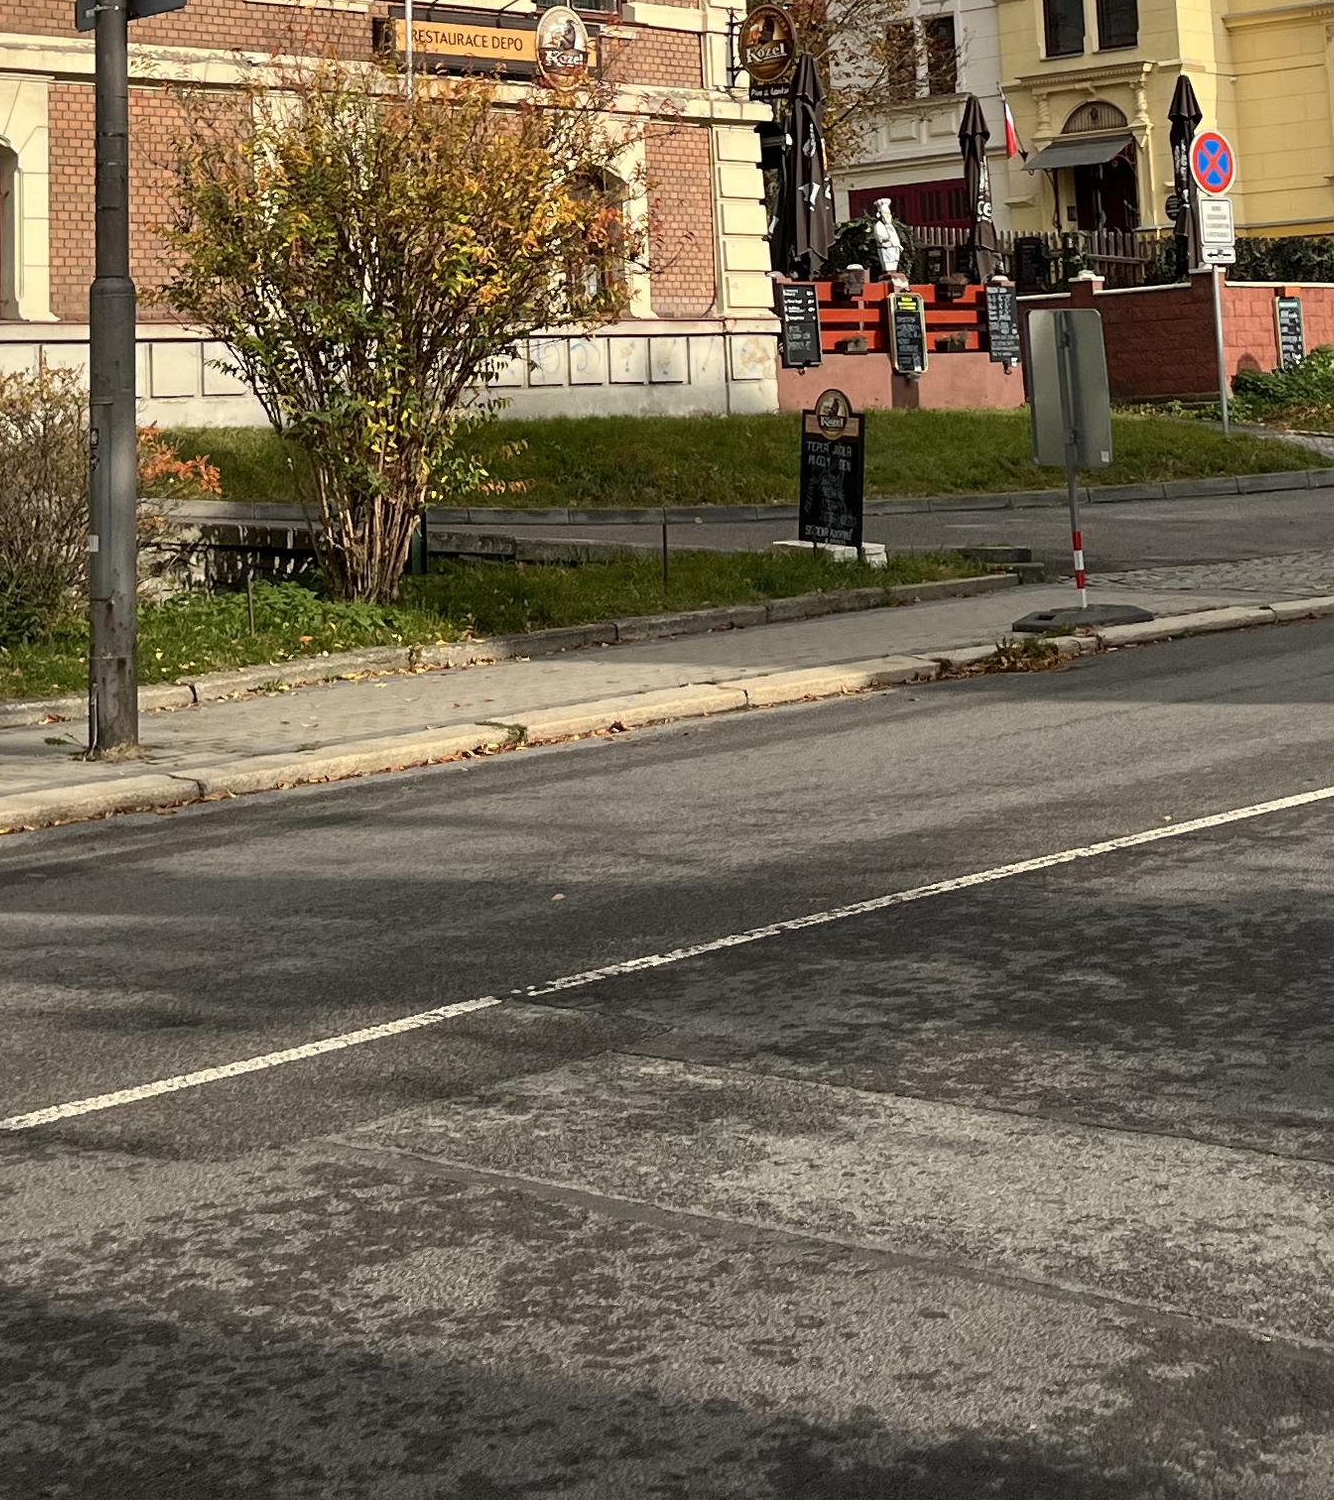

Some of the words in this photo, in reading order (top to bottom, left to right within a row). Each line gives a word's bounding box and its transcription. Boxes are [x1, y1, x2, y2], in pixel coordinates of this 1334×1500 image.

[412, 29, 489, 48] RESTAURACE
[492, 36, 523, 51] DEPO
[545, 50, 584, 67] Kozel
[747, 43, 787, 63] Kozel
[820, 416, 844, 429] Kozel
